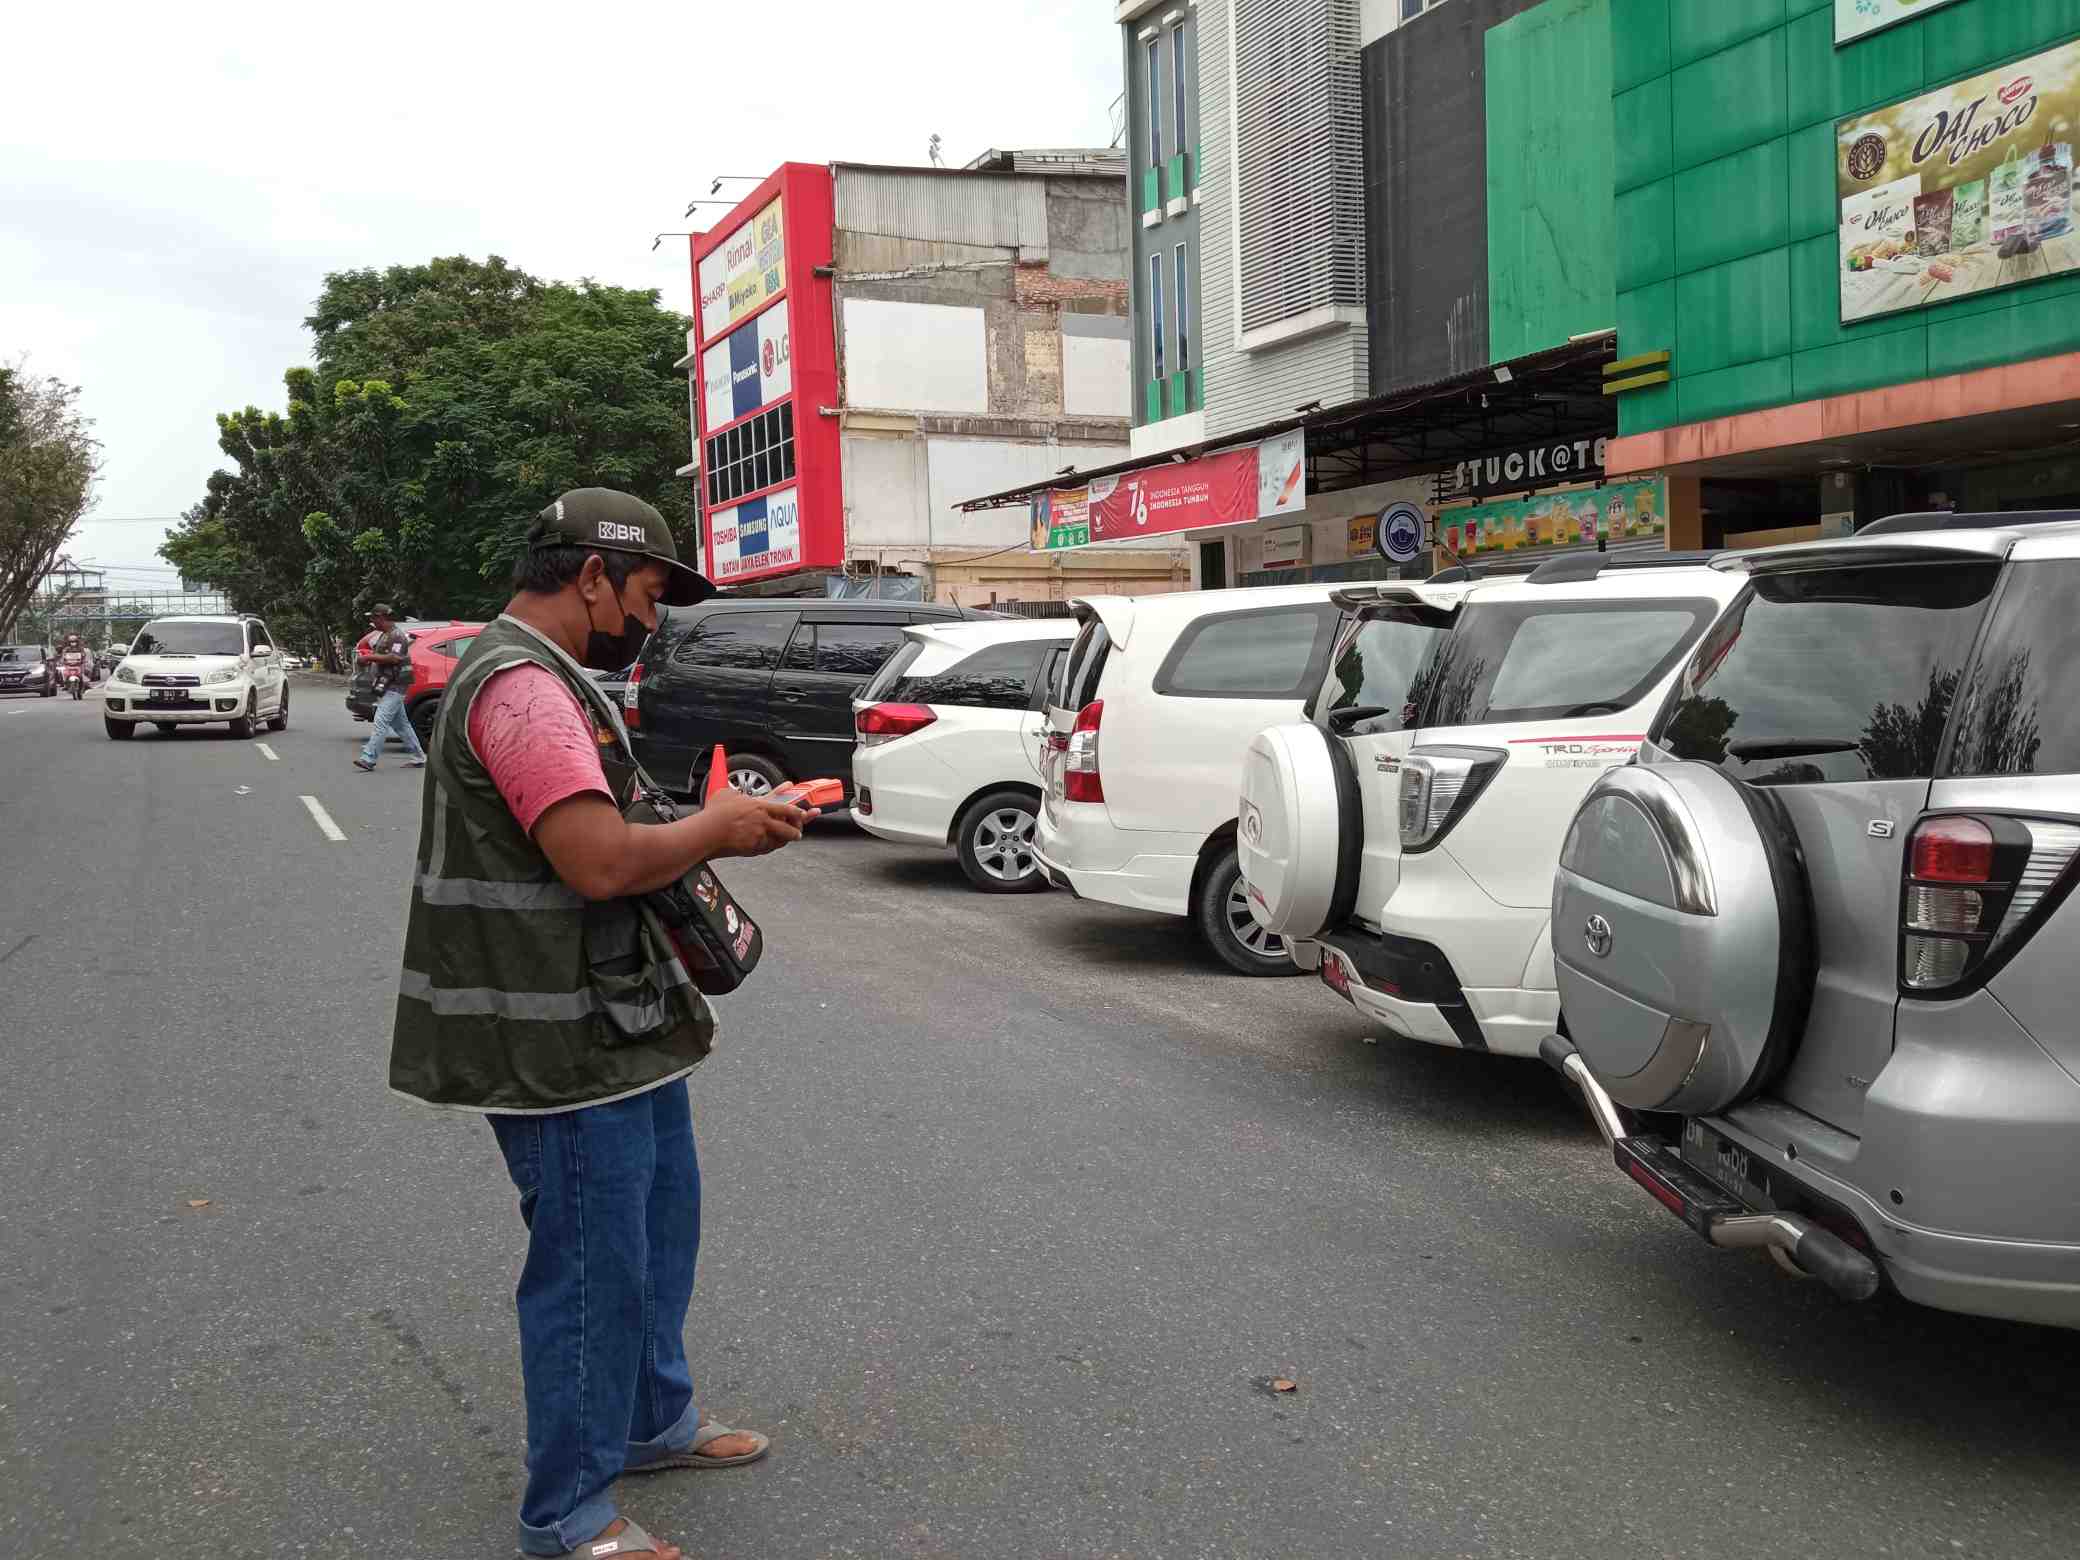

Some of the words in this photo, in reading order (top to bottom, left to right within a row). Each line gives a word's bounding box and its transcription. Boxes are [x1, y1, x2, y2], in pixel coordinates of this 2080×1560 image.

[1911, 96, 1987, 164] OAT
[1949, 96, 2037, 165] CHOCO
[727, 231, 753, 272] Rinnai
[701, 281, 726, 309] SHARP
[734, 284, 757, 306] Miyako
[776, 333, 789, 366] LG
[732, 360, 758, 384] Panasonic
[1127, 481, 1147, 525] 76
[1150, 487, 1180, 500] INDONESIA
[1150, 499, 1182, 511] INDONESIA
[740, 517, 768, 538] SAMSUNG
[770, 502, 798, 530] AQUA
[617, 526, 645, 543] BRI
[713, 527, 737, 545] TOSHIBA
[1541, 744, 1583, 754] TRD
